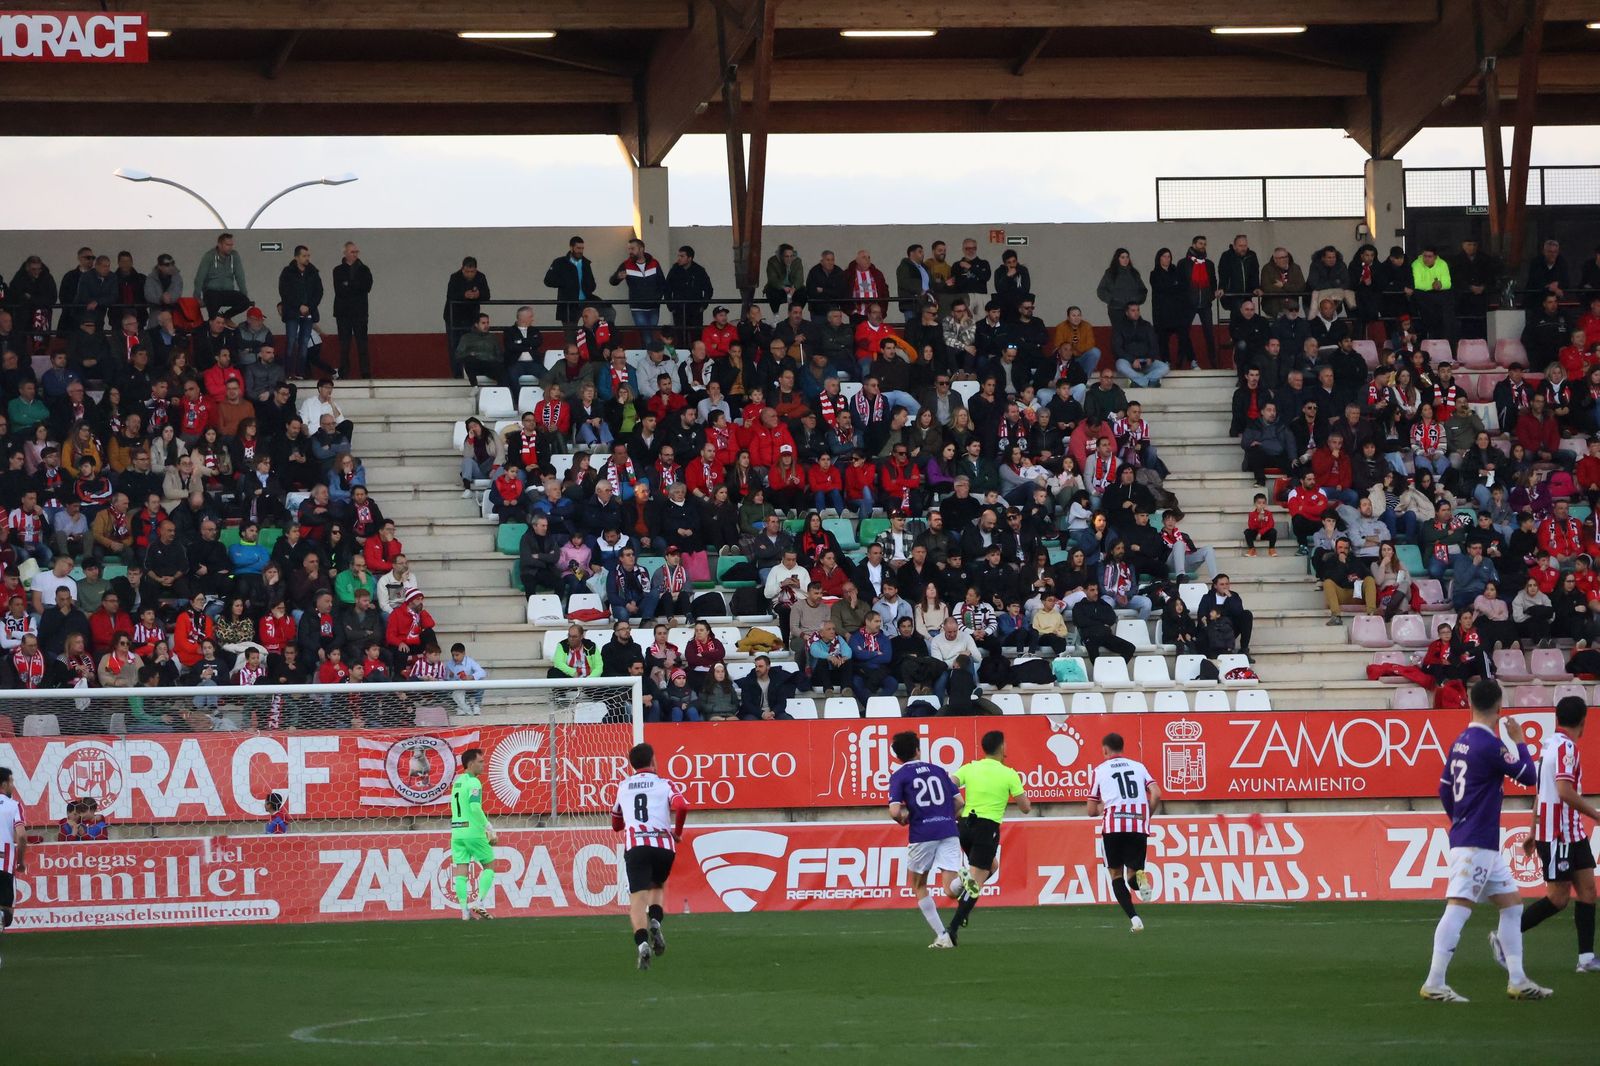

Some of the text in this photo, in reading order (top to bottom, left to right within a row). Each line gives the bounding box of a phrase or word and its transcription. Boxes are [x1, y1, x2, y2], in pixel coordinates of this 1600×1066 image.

[401, 740, 438, 748] FONDO
[859, 724, 965, 777] fiio
[1229, 718, 1448, 768] ZAMORA
[513, 745, 797, 783] CENTR ÓPTICO
[396, 782, 448, 800] MODORRO
[579, 781, 735, 807] RORTO
[628, 781, 654, 790] MARCELO
[913, 775, 945, 807] 20
[1066, 789, 1072, 797] Y
[1111, 770, 1139, 799] 16
[1228, 777, 1366, 792] AYUNTAMIENTO
[454, 791, 462, 818] 1
[634, 793, 649, 823] 8
[39, 852, 137, 871] bodegas
[786, 888, 892, 900] REFRIGERACION
[13, 904, 270, 926] ww.bodegasdelsumiller.com
